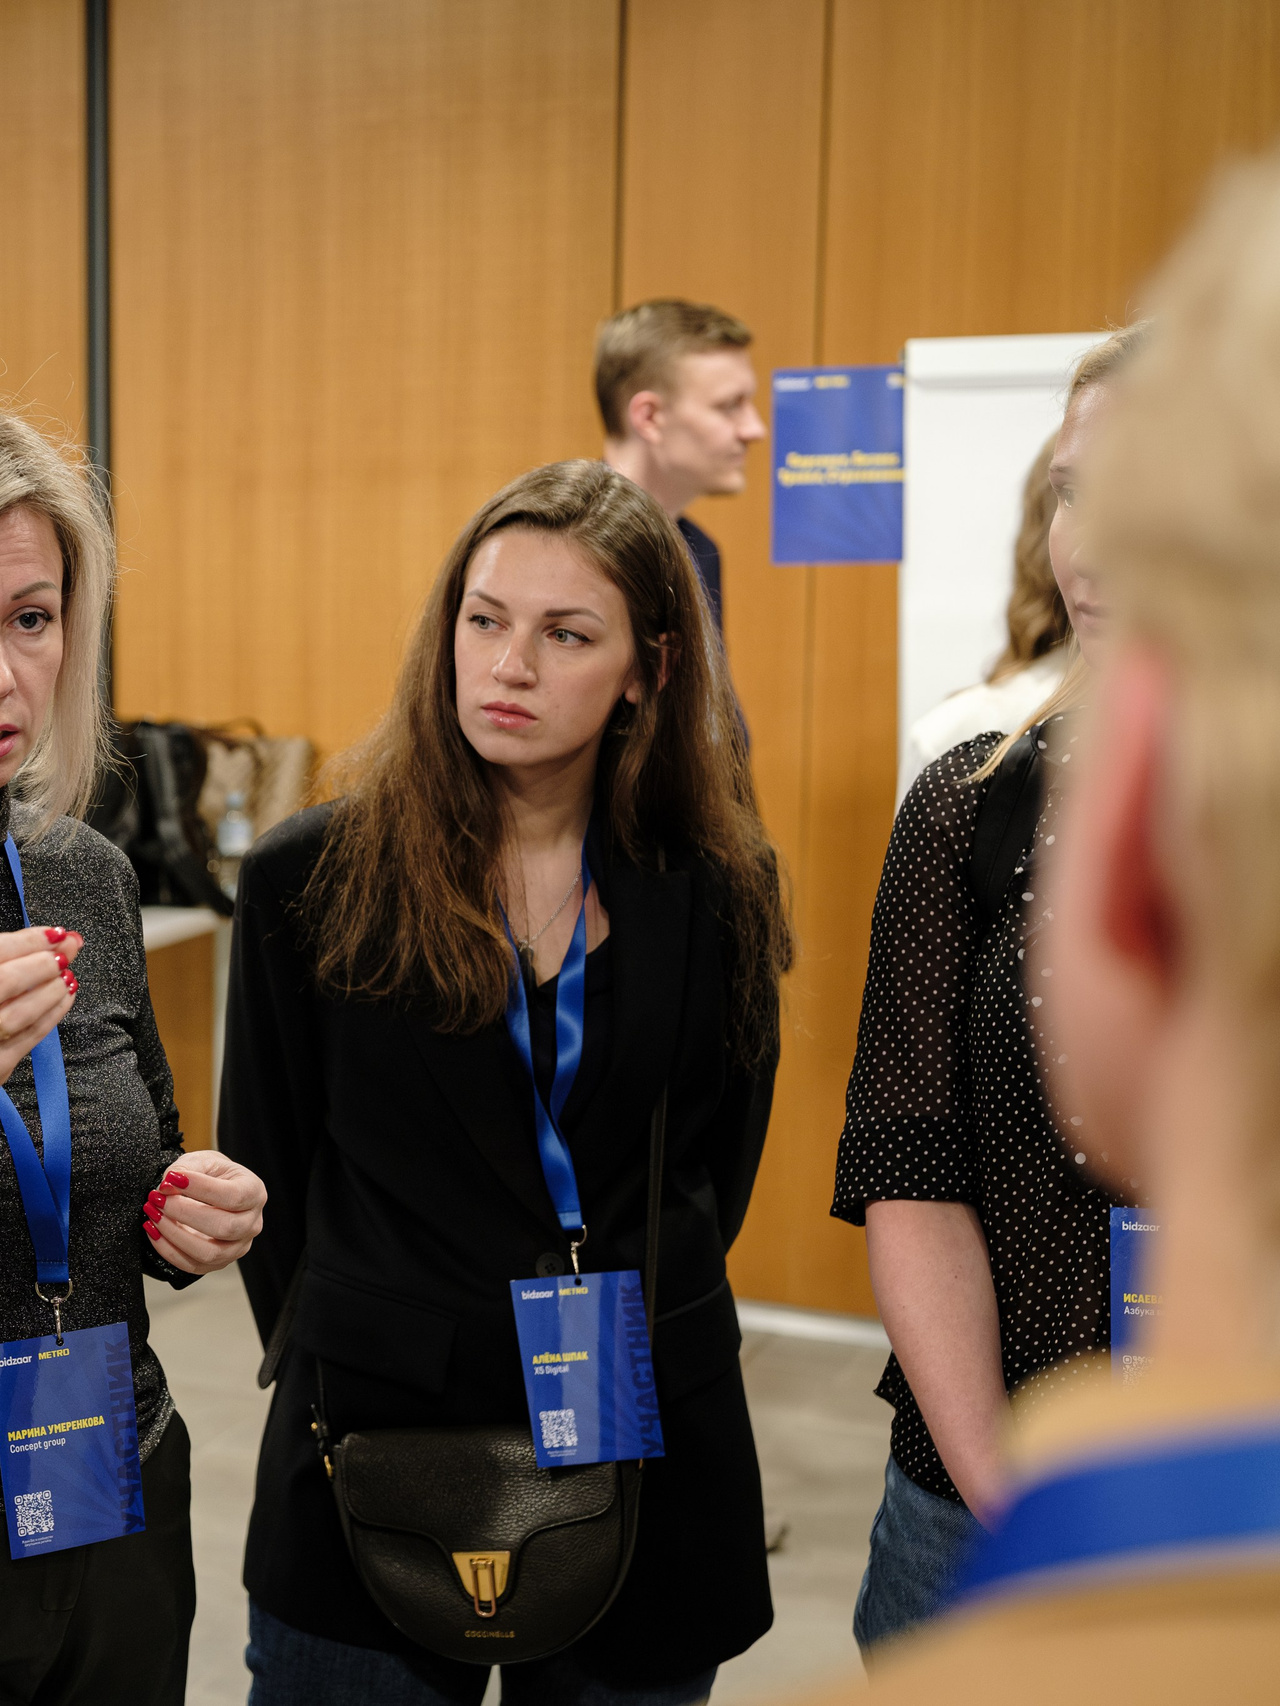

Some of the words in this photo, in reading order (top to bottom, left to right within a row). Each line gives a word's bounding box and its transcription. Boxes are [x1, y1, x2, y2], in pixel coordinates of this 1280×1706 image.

[1122, 1221, 1160, 1232] bidzaar
[521, 1289, 554, 1300] bidzaar
[558, 1286, 588, 1296] METRO
[1124, 1305, 1155, 1317] Азбука
[38, 1348, 70, 1360] METRO
[532, 1351, 562, 1365] АЛЁНА
[562, 1351, 588, 1362] ШПАК
[545, 1364, 569, 1376] Digital
[7, 1426, 47, 1442] МАРИНА
[47, 1415, 105, 1435] УМЕРЕНКОВА
[9, 1442, 42, 1453] Concept
[43, 1437, 66, 1450] group
[464, 1629, 516, 1639] COCCINELLE
